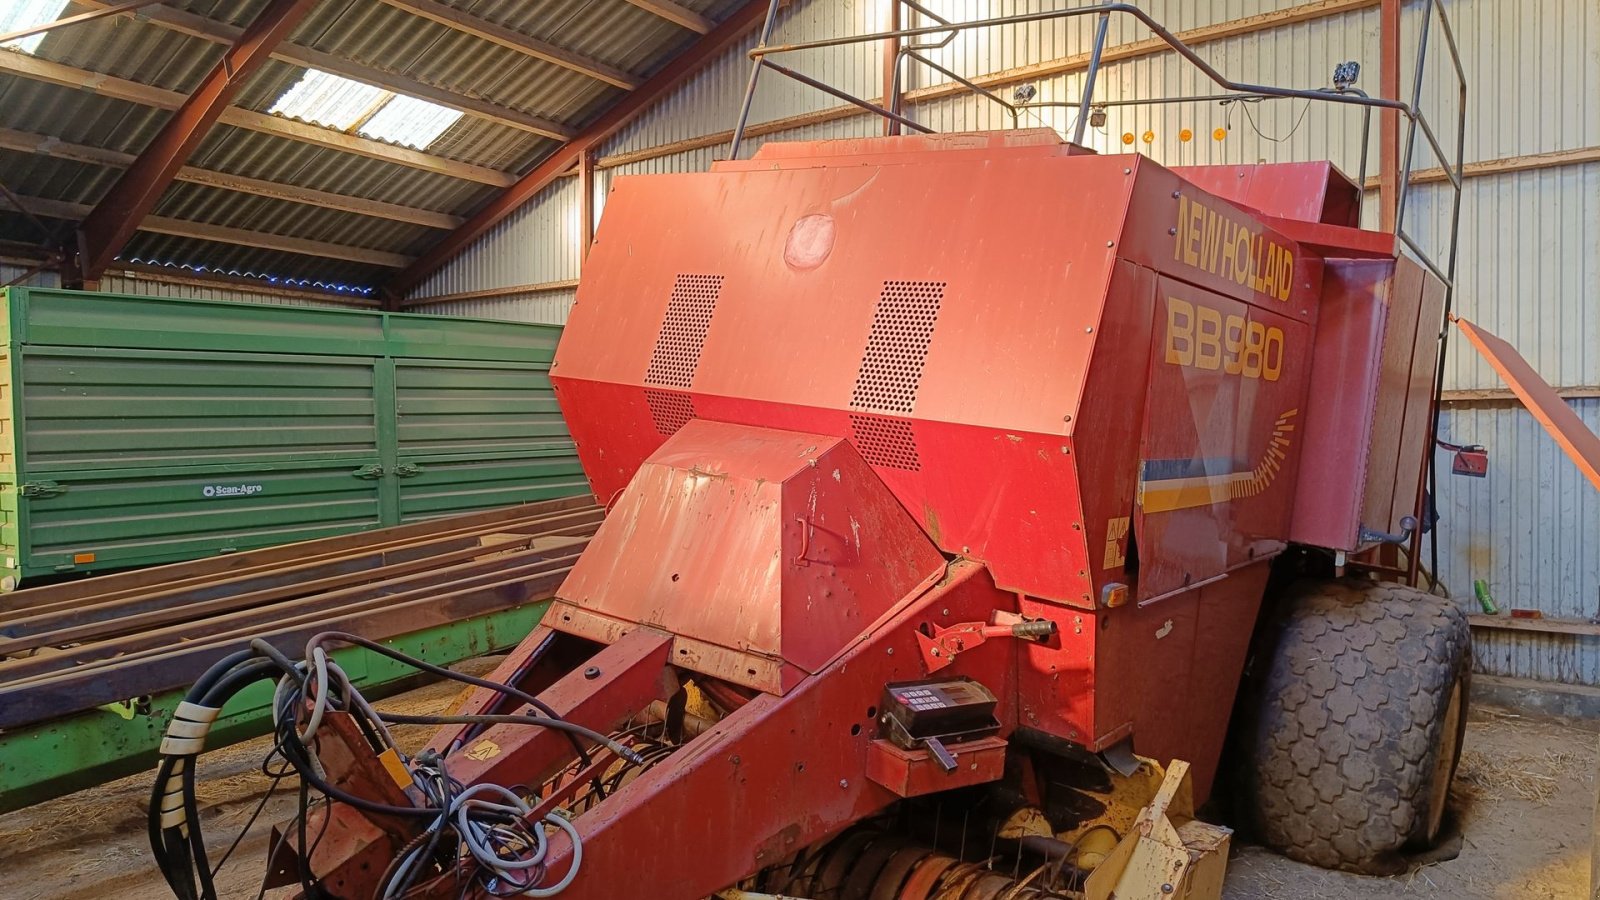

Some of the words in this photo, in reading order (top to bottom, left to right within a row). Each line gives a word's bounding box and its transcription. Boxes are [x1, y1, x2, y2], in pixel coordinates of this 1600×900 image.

[1174, 194, 1223, 274] NEW
[1220, 218, 1294, 302] HOLLAND
[1165, 296, 1284, 382] BB980
[215, 484, 263, 494] Scan-Agro
